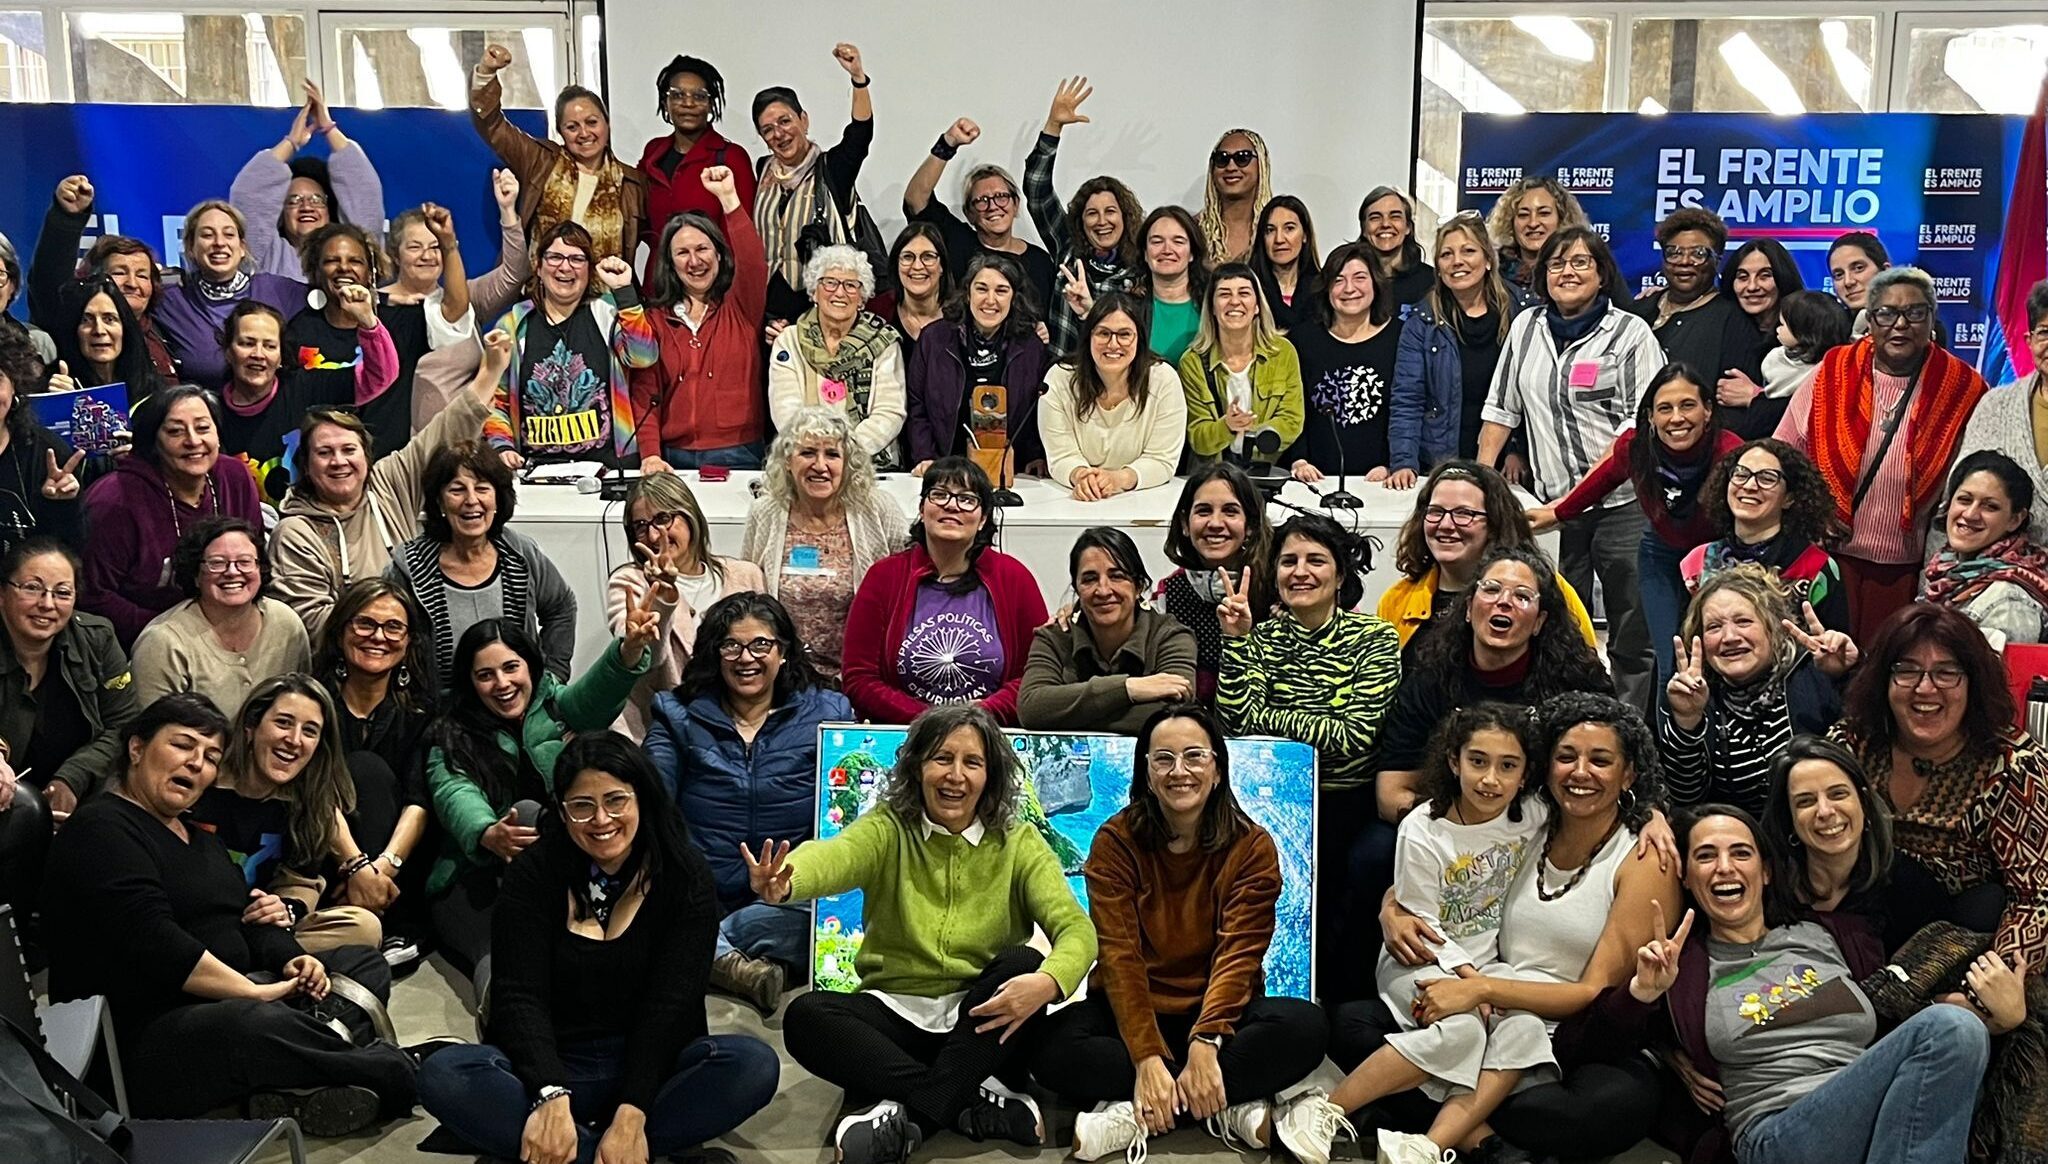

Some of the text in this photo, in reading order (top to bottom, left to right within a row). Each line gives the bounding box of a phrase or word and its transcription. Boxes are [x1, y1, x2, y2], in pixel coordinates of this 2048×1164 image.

[1658, 148, 1884, 185] EL FRENTE
[1466, 168, 1523, 178] EL FRENTE
[1558, 168, 1614, 178] EL FRENTE
[1925, 168, 1982, 178] EL FRENTE
[1465, 178, 1479, 187] ES
[1572, 178, 1614, 187] AMPLIO
[1924, 179, 1982, 188] ES AMPLIO
[1655, 189, 1880, 224] ES AMPLIO
[1590, 223, 1610, 233] NTE
[1919, 224, 1976, 234] EL FRENTE
[1918, 234, 1975, 244] ES AMPLIO
[1642, 276, 1655, 286] EL
[1936, 287, 1971, 296] MPLIO
[1955, 323, 1968, 333] EL
[1955, 333, 1968, 342] ES
[898, 616, 936, 656] PRESAS
[937, 612, 994, 643] POLÍTICAS
